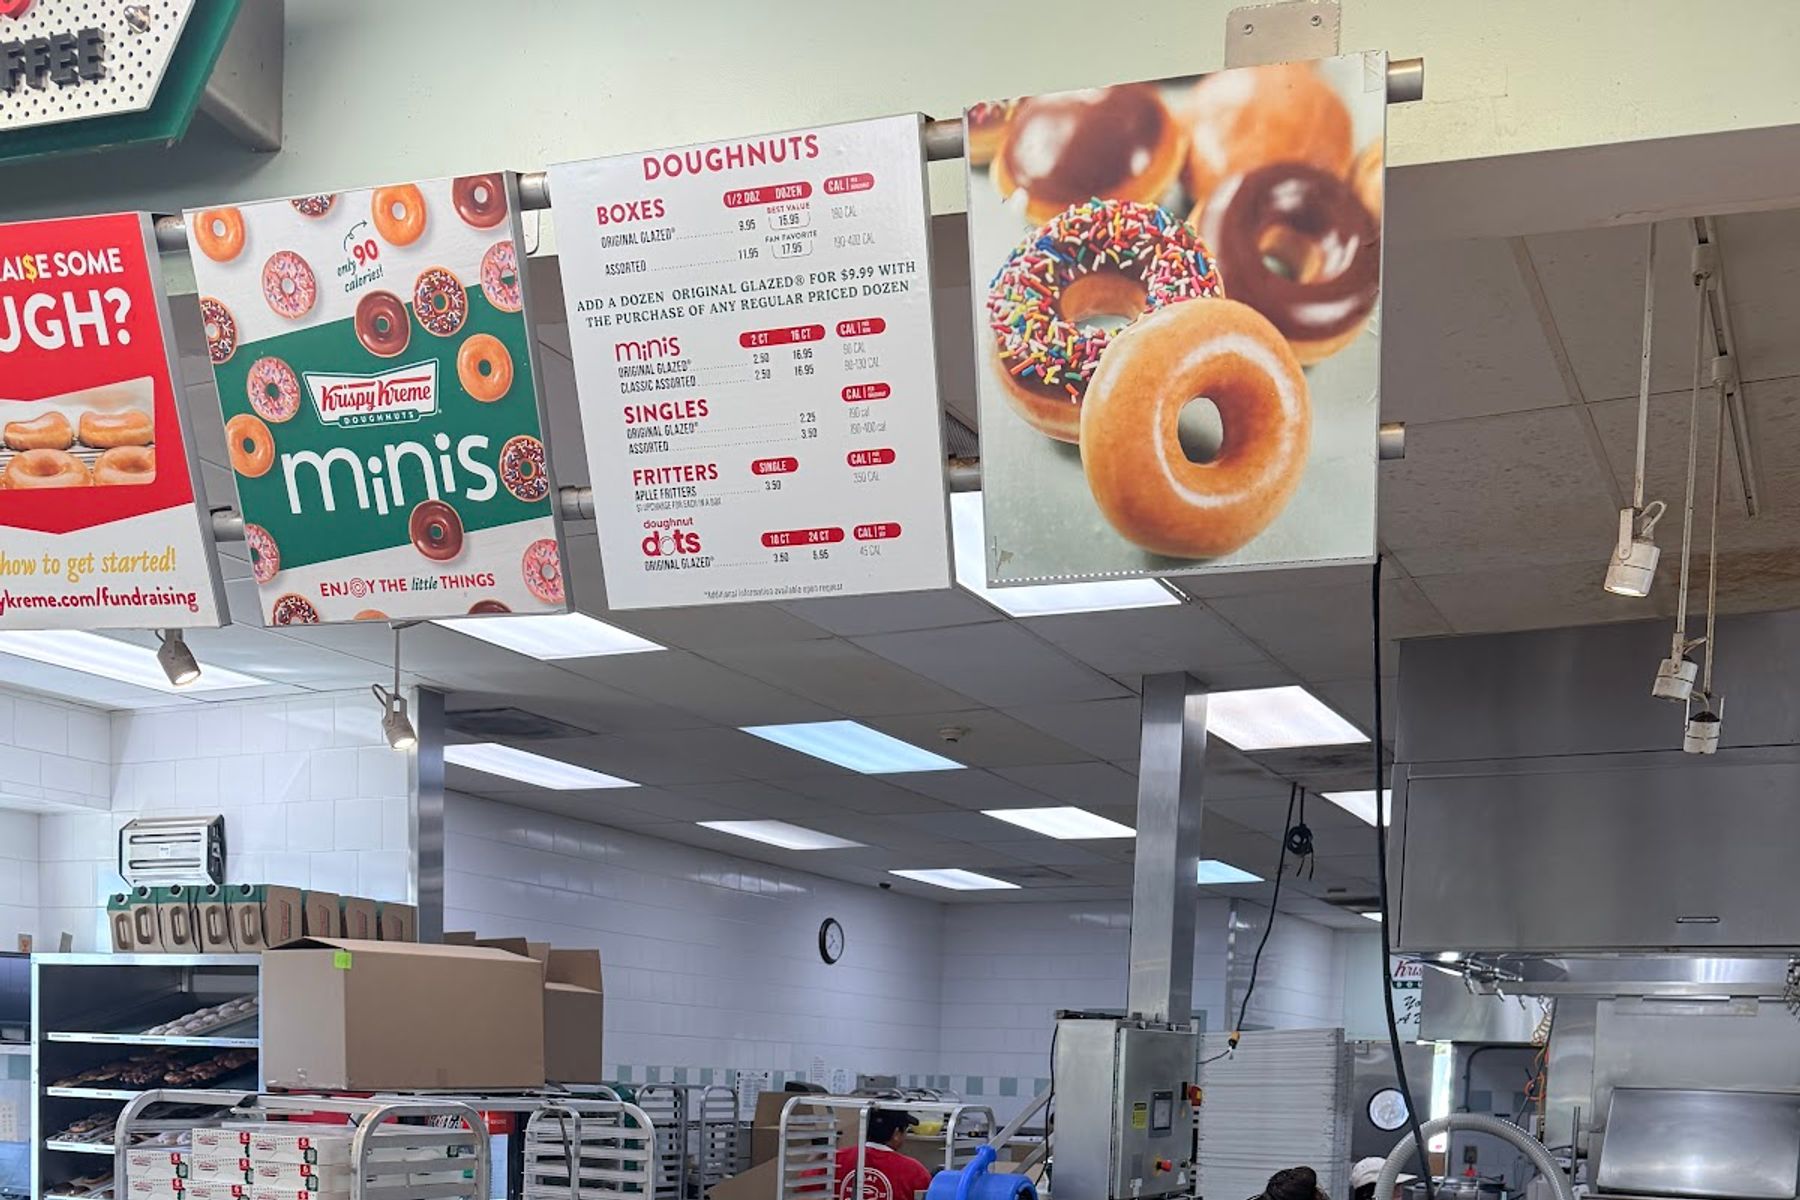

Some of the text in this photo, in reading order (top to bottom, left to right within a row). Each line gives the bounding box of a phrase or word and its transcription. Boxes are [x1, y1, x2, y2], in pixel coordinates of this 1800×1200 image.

[643, 134, 819, 181] DOUGHNUTS
[727, 184, 803, 206] 1/2 DOZ DOZEN
[828, 179, 845, 192] CAL
[597, 198, 665, 225] BOXES
[767, 202, 810, 214] BEST VALUE
[601, 232, 639, 249] ORIGINAL
[778, 213, 800, 227] 15.95
[765, 230, 817, 243] FAN FAVORITE
[0, 247, 124, 283] AI$E SOME
[338, 239, 379, 278] only 90
[605, 259, 647, 275] ASSORTED
[781, 242, 803, 255] 17.95
[344, 263, 384, 294] calories!
[577, 299, 604, 312] ADD
[608, 297, 616, 308] A
[620, 291, 664, 307] DOZEN
[672, 283, 736, 301] ORIGINAL
[809, 271, 837, 285] FOR
[840, 265, 874, 282] $9.99
[878, 261, 915, 276] WITH
[586, 280, 909, 328] THE PURCHASE OF ANY REGULAR PRICED DOZEN
[751, 328, 811, 346] 2 CT 16 CT
[840, 324, 856, 335] CAL
[615, 336, 681, 361] minis
[618, 363, 655, 378] ORIGINAL
[753, 353, 769, 364] 2.50
[793, 348, 813, 360] 16.95
[621, 380, 654, 394] CLASSIC
[655, 375, 696, 390] ASSORTED
[755, 369, 771, 380] 2.50
[794, 364, 814, 376] 16.95
[321, 375, 432, 411] Krispy Kreme
[846, 388, 861, 400] CAL
[343, 411, 414, 425] DOUGHNUTS
[624, 399, 709, 424] SINGLES
[627, 426, 663, 439] ORIGINAL
[800, 412, 816, 423] 2.25
[629, 441, 669, 455] ASSORTED
[801, 428, 817, 439] 3.50
[759, 461, 787, 473] SINGLE
[851, 453, 867, 465] CAL
[281, 432, 498, 515] minis
[633, 463, 718, 486] FRITTERS
[660, 486, 697, 500] FRITTERS
[765, 480, 781, 491] 3.50
[643, 517, 694, 531] doughnut
[857, 527, 872, 538] CAL
[642, 529, 701, 556] dots
[780, 533, 790, 544] CT
[808, 531, 817, 543] 24
[819, 530, 830, 541] CT
[0, 545, 176, 583] how to get started!
[644, 559, 680, 571] ORIGINAL
[379, 578, 407, 593] THE
[411, 576, 438, 590] little
[439, 573, 495, 589] THINGS
